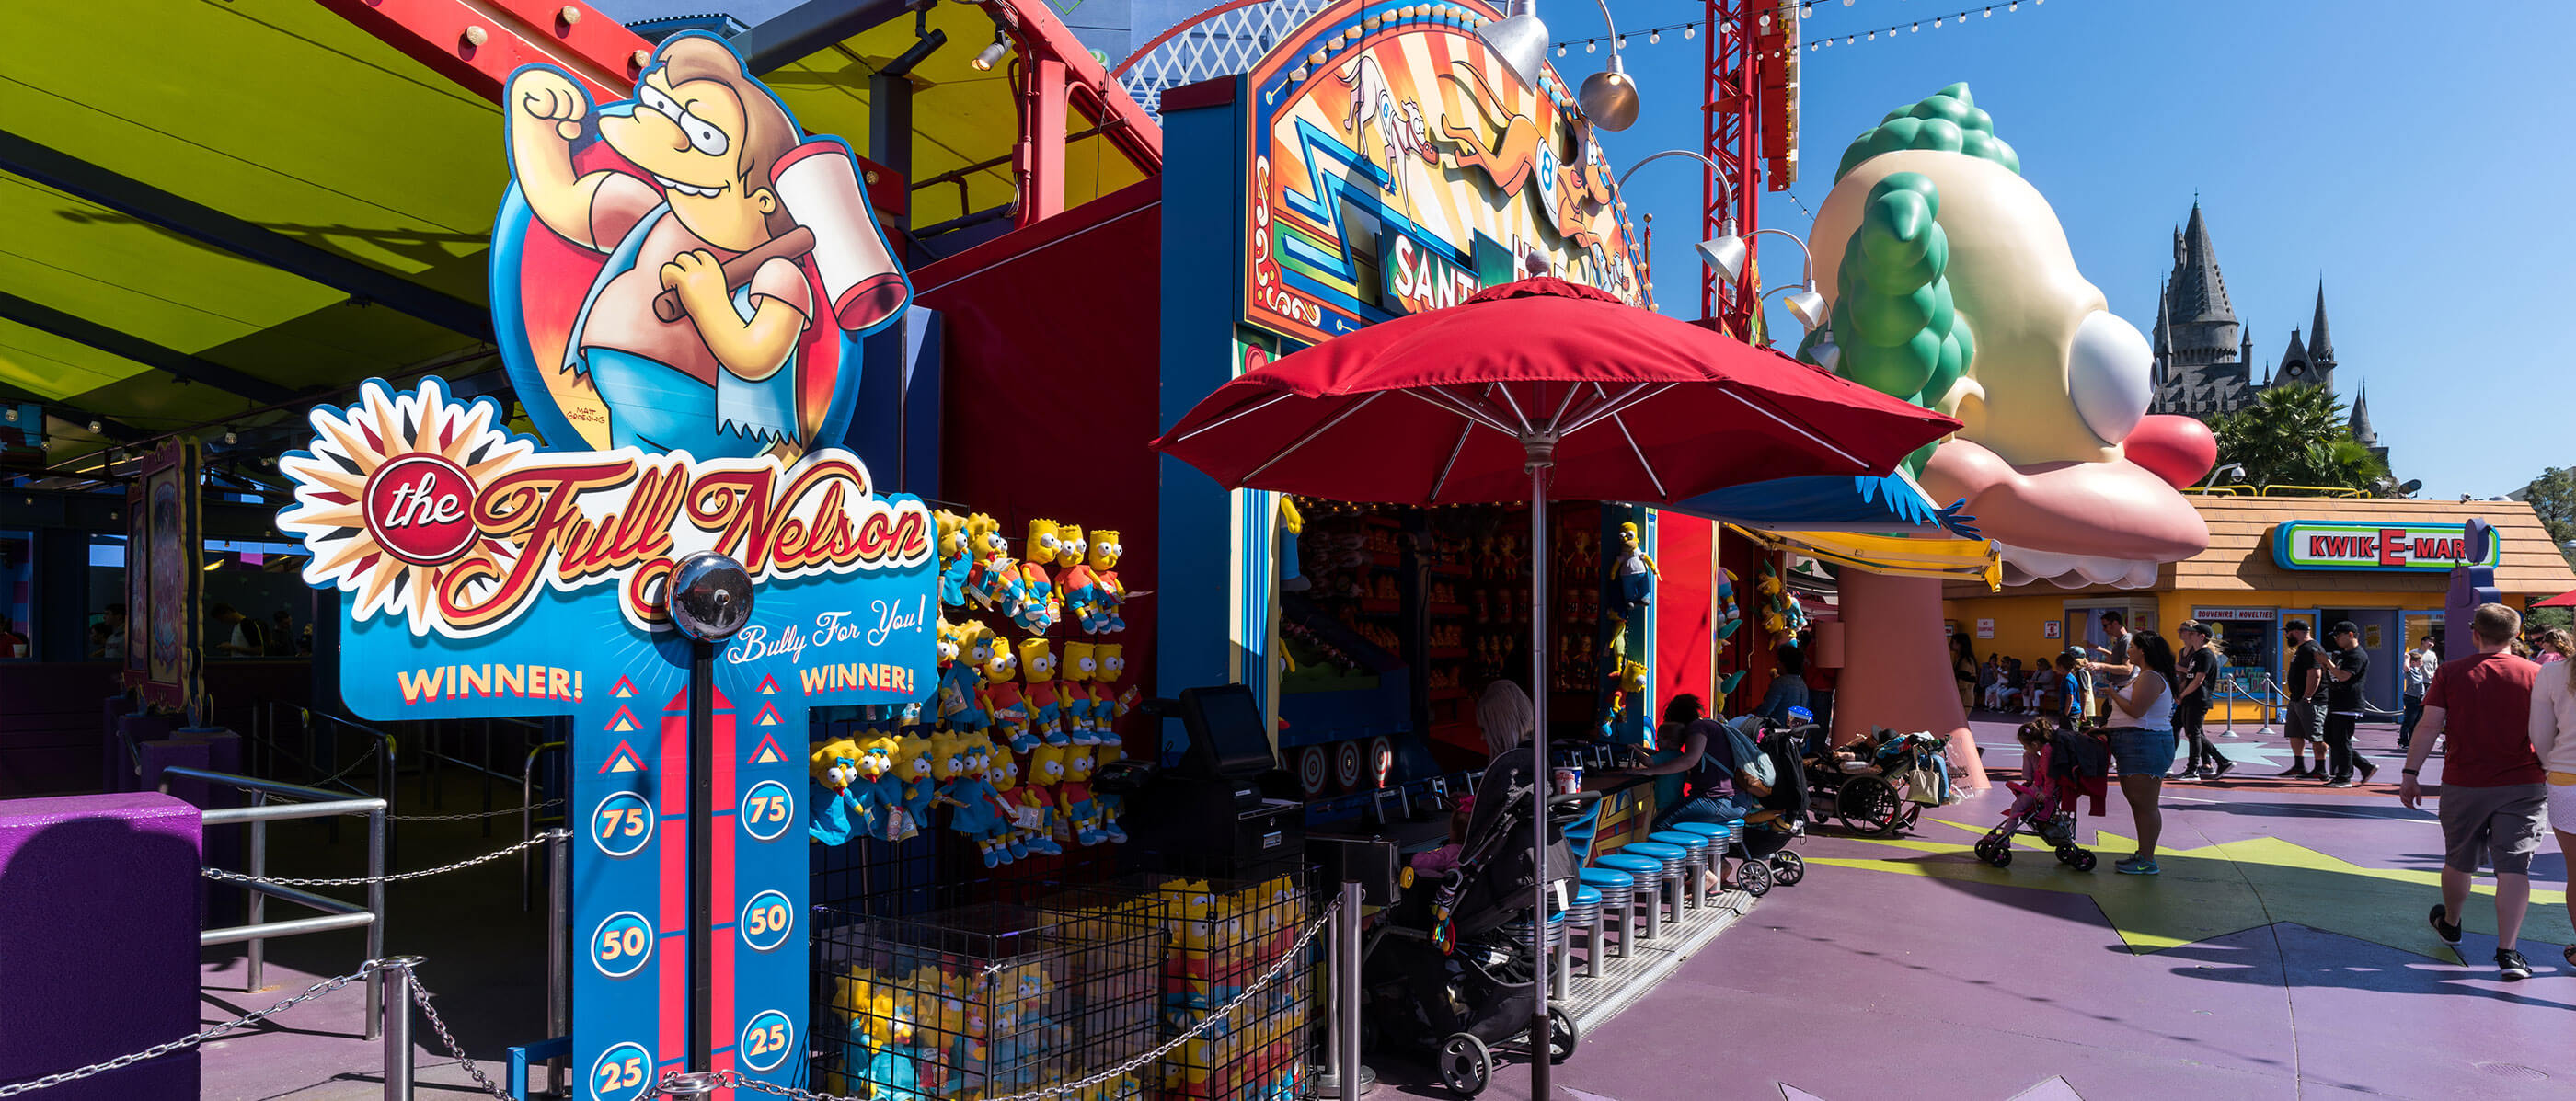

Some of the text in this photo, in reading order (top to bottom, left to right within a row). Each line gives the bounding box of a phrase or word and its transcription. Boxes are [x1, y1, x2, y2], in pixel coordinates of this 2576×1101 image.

[1383, 102, 1390, 119] 6
[1541, 150, 1553, 191] 8
[1394, 234, 1483, 309] SANT
[385, 458, 927, 631] the Full Nelson
[2310, 528, 2466, 567] KWIK-E-MAR
[727, 593, 926, 664] Bully For You!
[2198, 610, 2233, 618] SOUVENIRS
[2239, 611, 2273, 619] NOVELTIES
[397, 663, 583, 705] WINNER!
[799, 662, 914, 697] WINNER!
[602, 809, 645, 839] 75
[750, 796, 786, 824] 75
[750, 904, 787, 935] 50
[601, 926, 645, 960] 50
[749, 1023, 786, 1057] 25
[599, 1058, 643, 1095] 25
